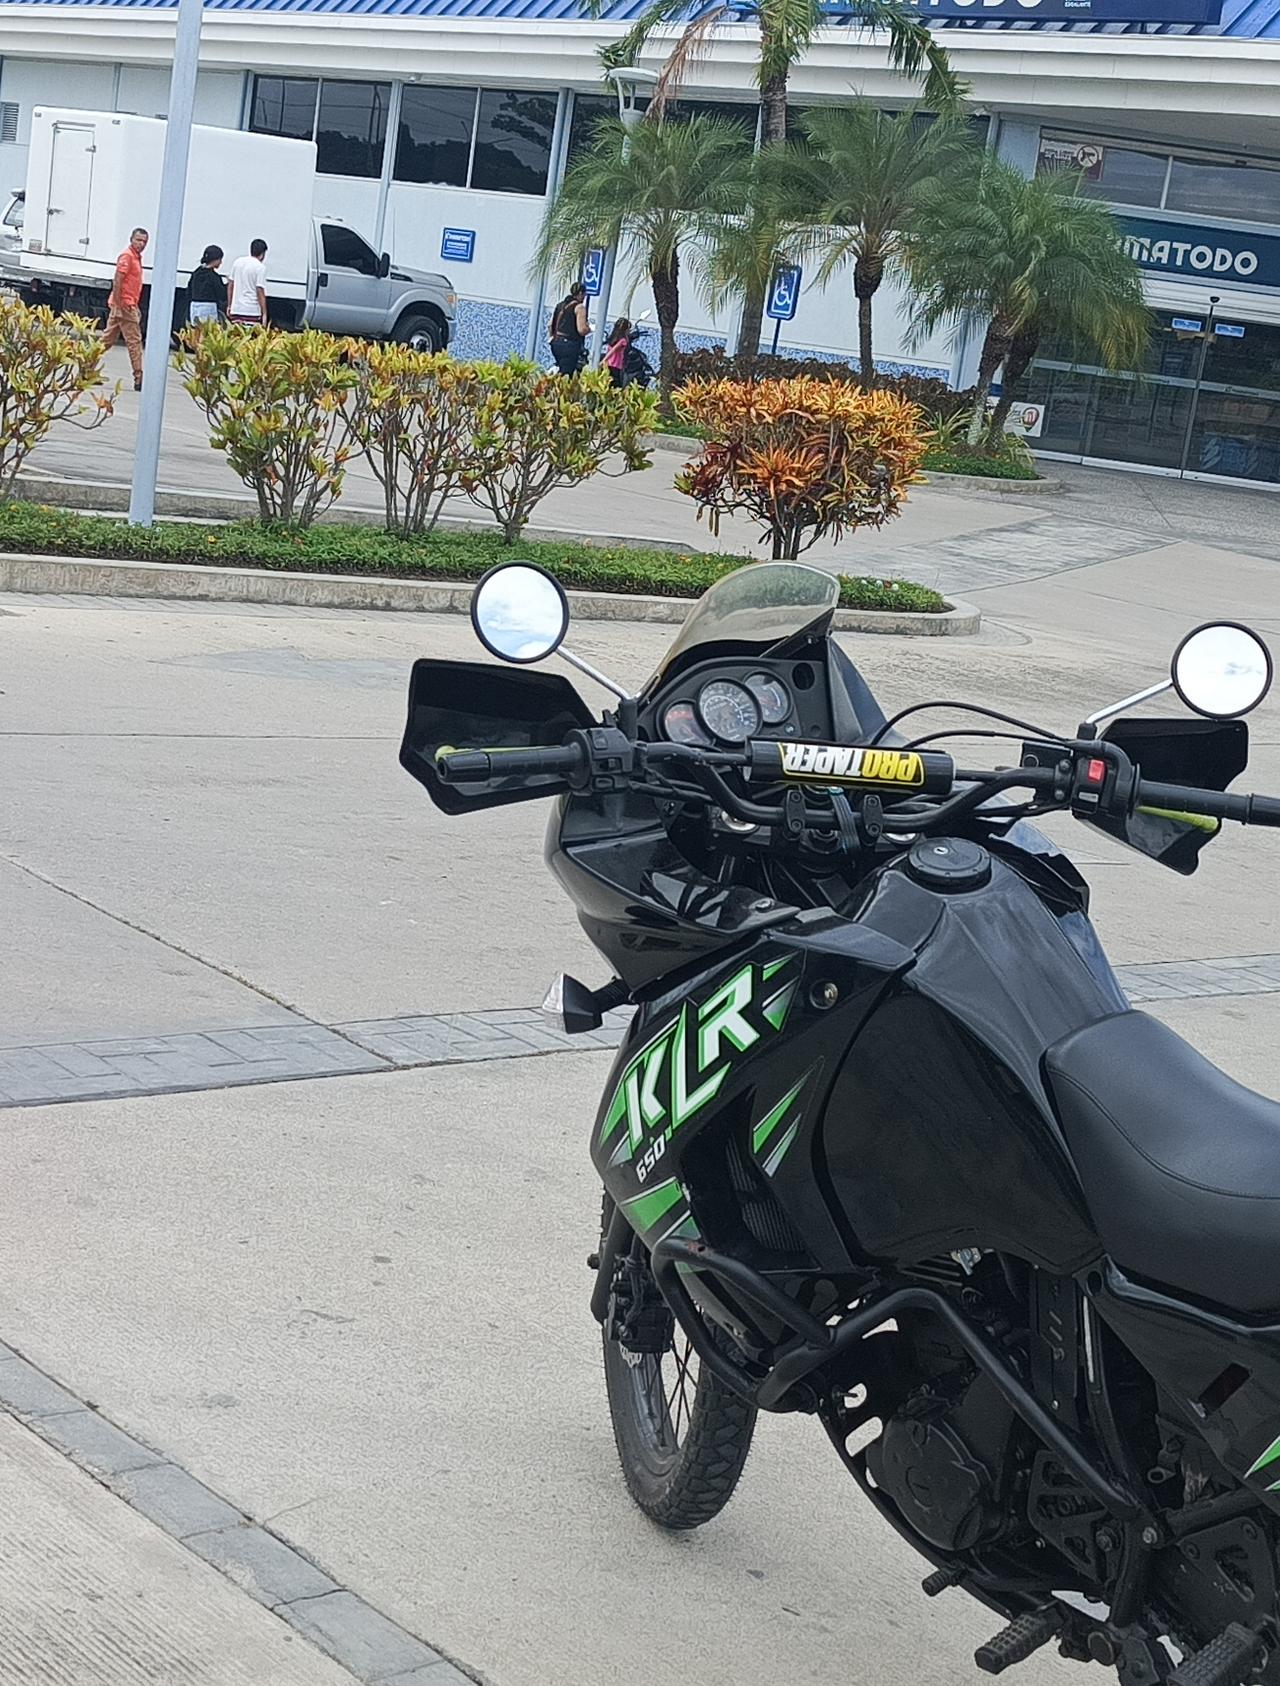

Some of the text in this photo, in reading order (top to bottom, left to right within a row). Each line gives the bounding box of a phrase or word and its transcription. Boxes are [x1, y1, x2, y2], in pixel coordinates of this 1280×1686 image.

[785, 743, 918, 782] PROTAPER
[623, 964, 761, 1152] KLR
[635, 1133, 666, 1184] 650
